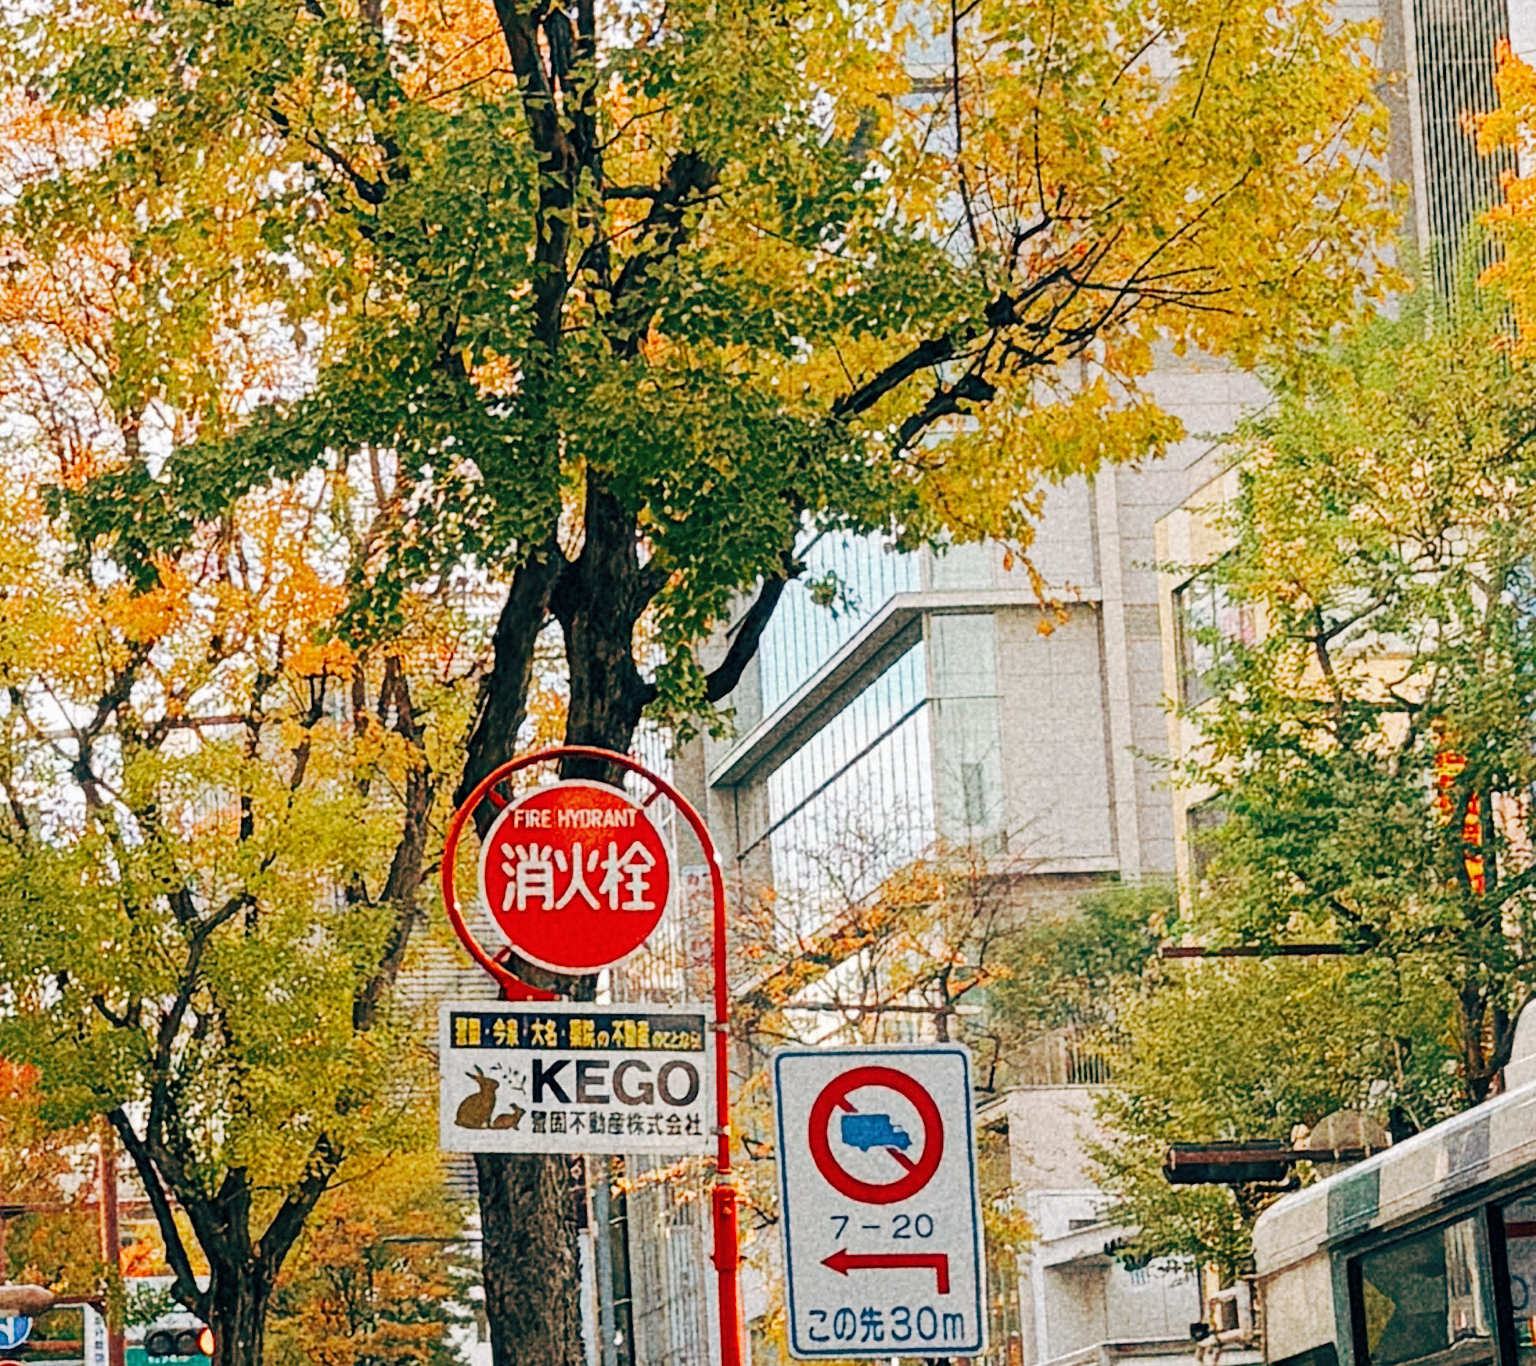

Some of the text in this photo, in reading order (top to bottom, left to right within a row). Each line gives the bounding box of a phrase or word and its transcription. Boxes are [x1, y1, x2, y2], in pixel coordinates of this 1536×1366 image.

[513, 807, 638, 829] FIRE HYDRANT
[500, 840, 656, 912] 消火栓
[530, 1058, 701, 1107] KEGO
[808, 1306, 965, 1343] この先30m
